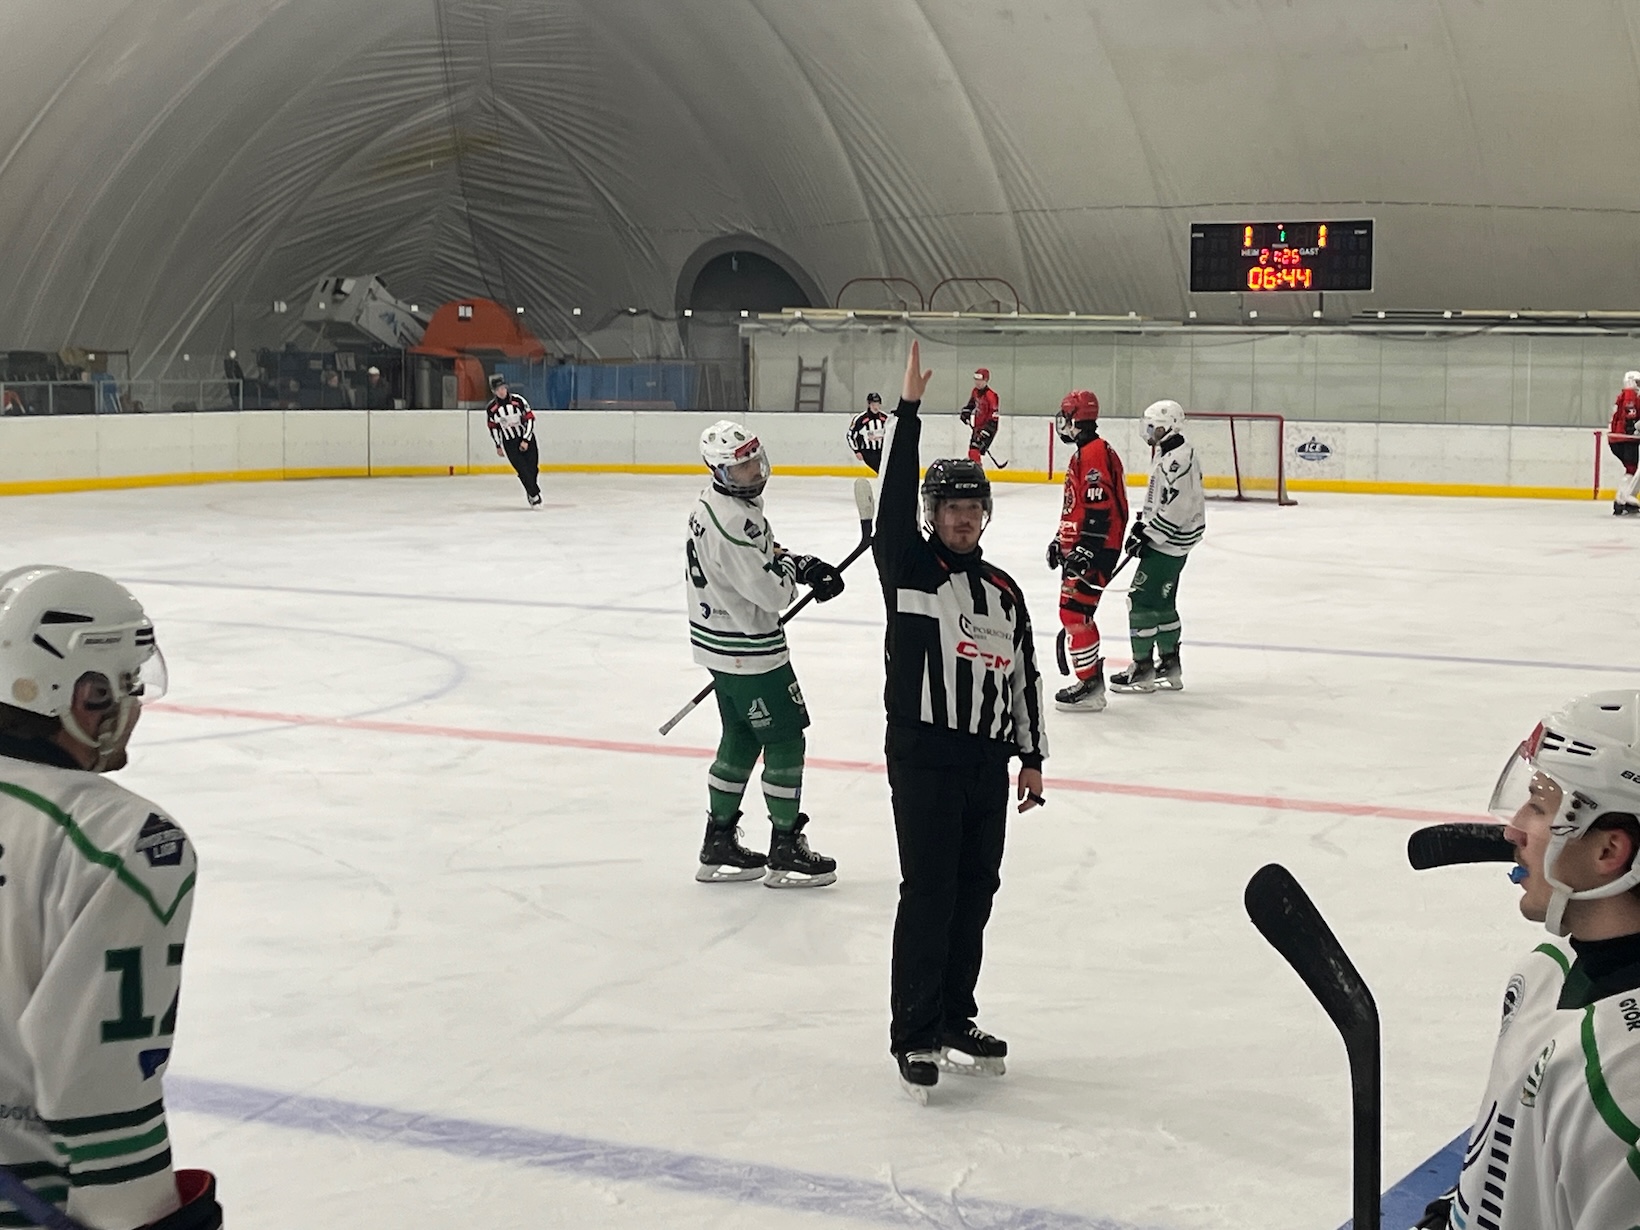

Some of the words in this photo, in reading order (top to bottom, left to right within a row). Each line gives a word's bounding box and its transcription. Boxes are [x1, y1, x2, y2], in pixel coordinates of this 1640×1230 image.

[1245, 226, 1253, 247] 1
[1318, 225, 1327, 247] 1
[1299, 247, 1319, 256] GAST
[1248, 267, 1312, 289] 06:44
[1086, 487, 1104, 501] 44
